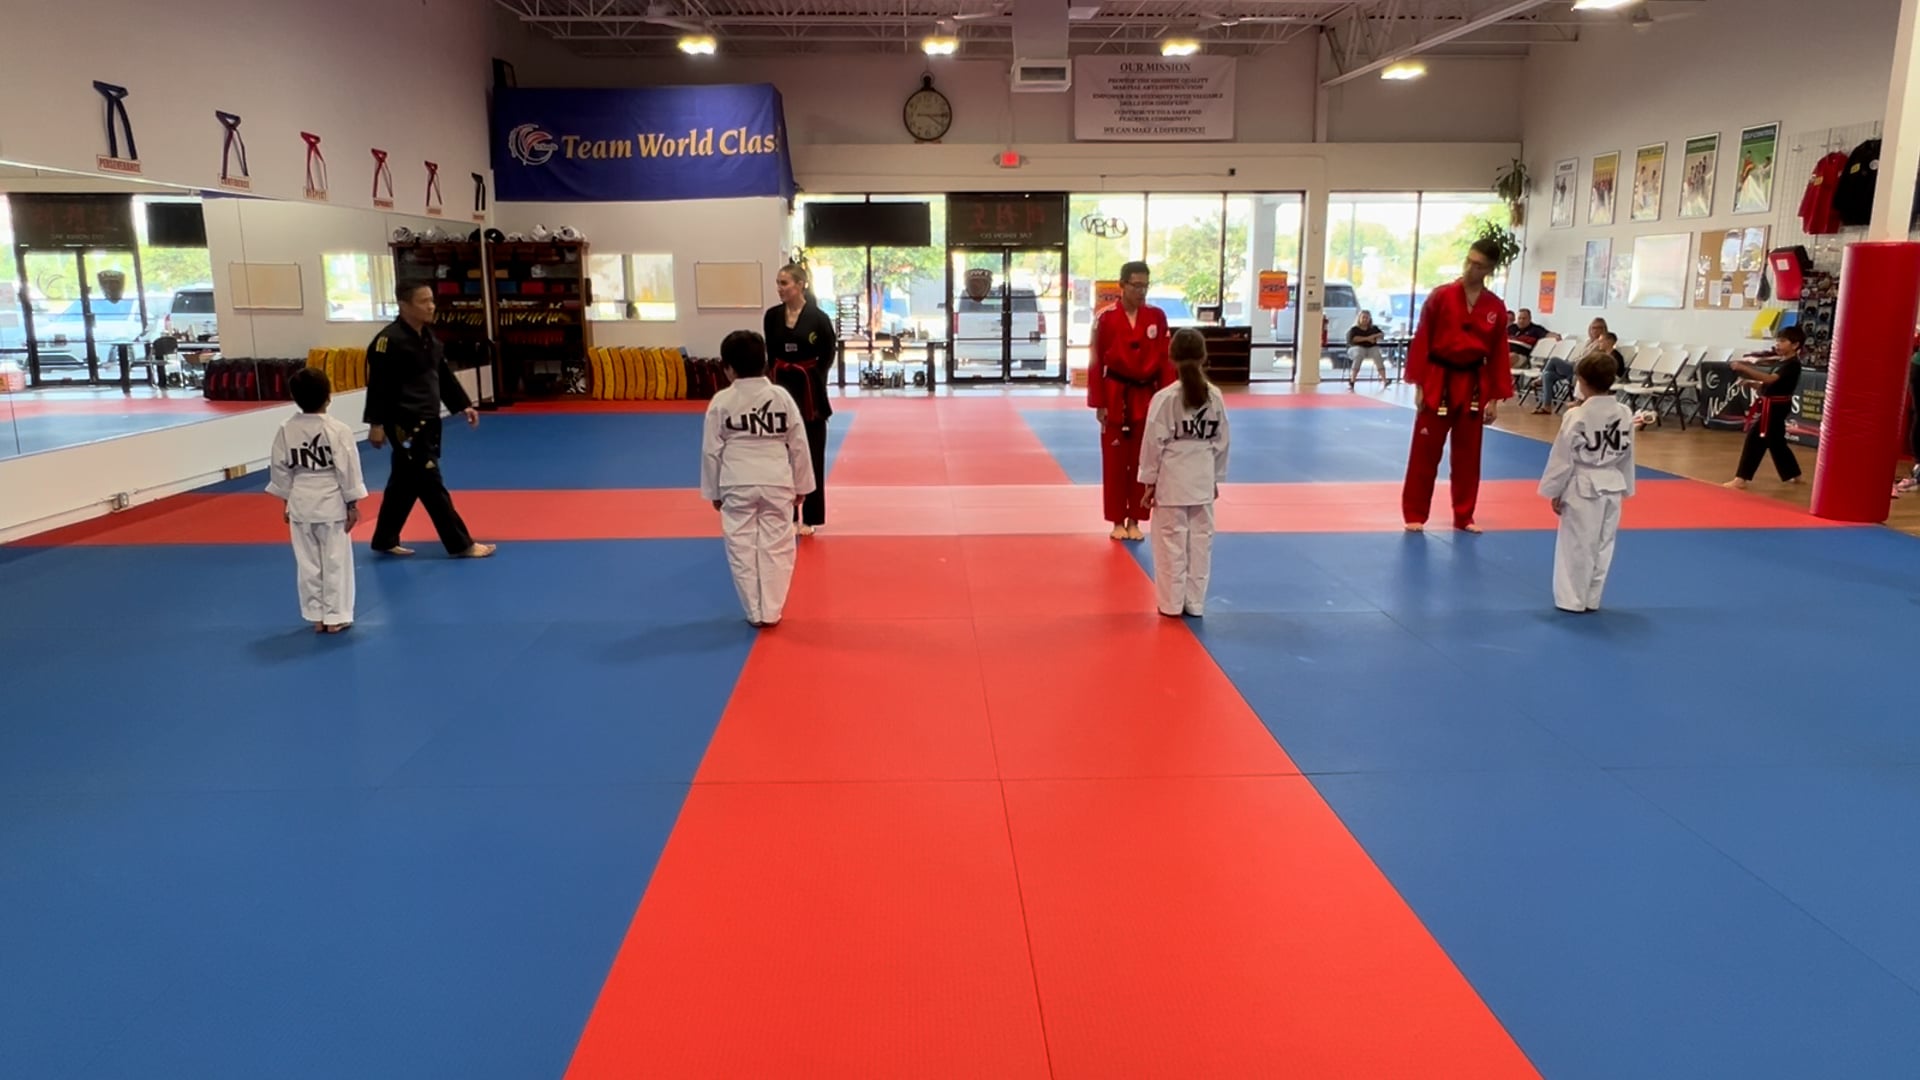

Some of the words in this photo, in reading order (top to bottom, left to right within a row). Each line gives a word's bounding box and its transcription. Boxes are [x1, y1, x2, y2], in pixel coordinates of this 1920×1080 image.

[1119, 62, 1143, 72] OUR
[1145, 62, 1191, 72] MISSION
[1104, 127, 1114, 135] WE
[1116, 127, 1131, 135] CAN
[1132, 127, 1151, 135] MAKE
[1159, 127, 1206, 135] DIFFERENCE!
[562, 133, 632, 159] Team
[637, 126, 714, 158] World
